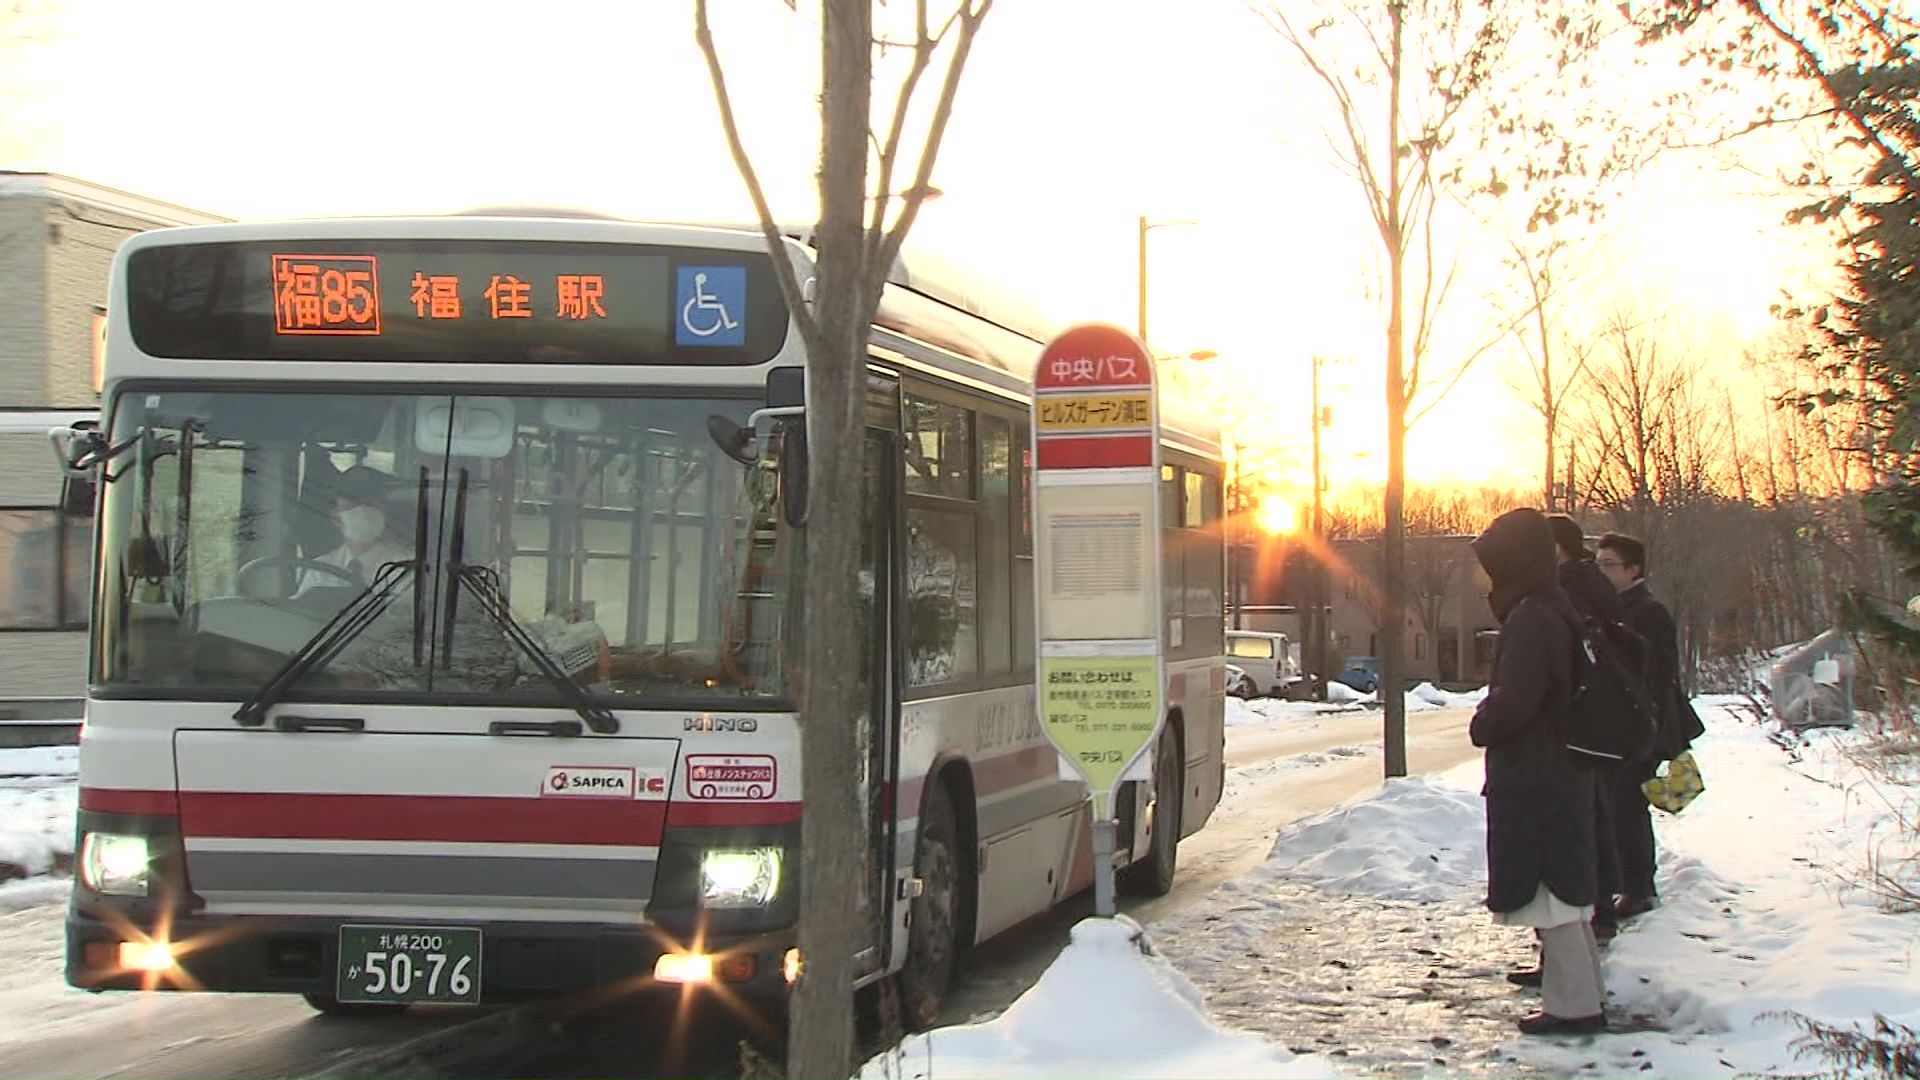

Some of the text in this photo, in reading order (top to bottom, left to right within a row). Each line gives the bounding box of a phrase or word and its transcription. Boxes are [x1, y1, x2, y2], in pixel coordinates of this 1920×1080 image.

[278, 259, 376, 327] 福85
[1051, 356, 1137, 382] 中央バス
[683, 717, 758, 733] HINO
[572, 775, 625, 789] SAPICA
[365, 952, 472, 996] 50-76
